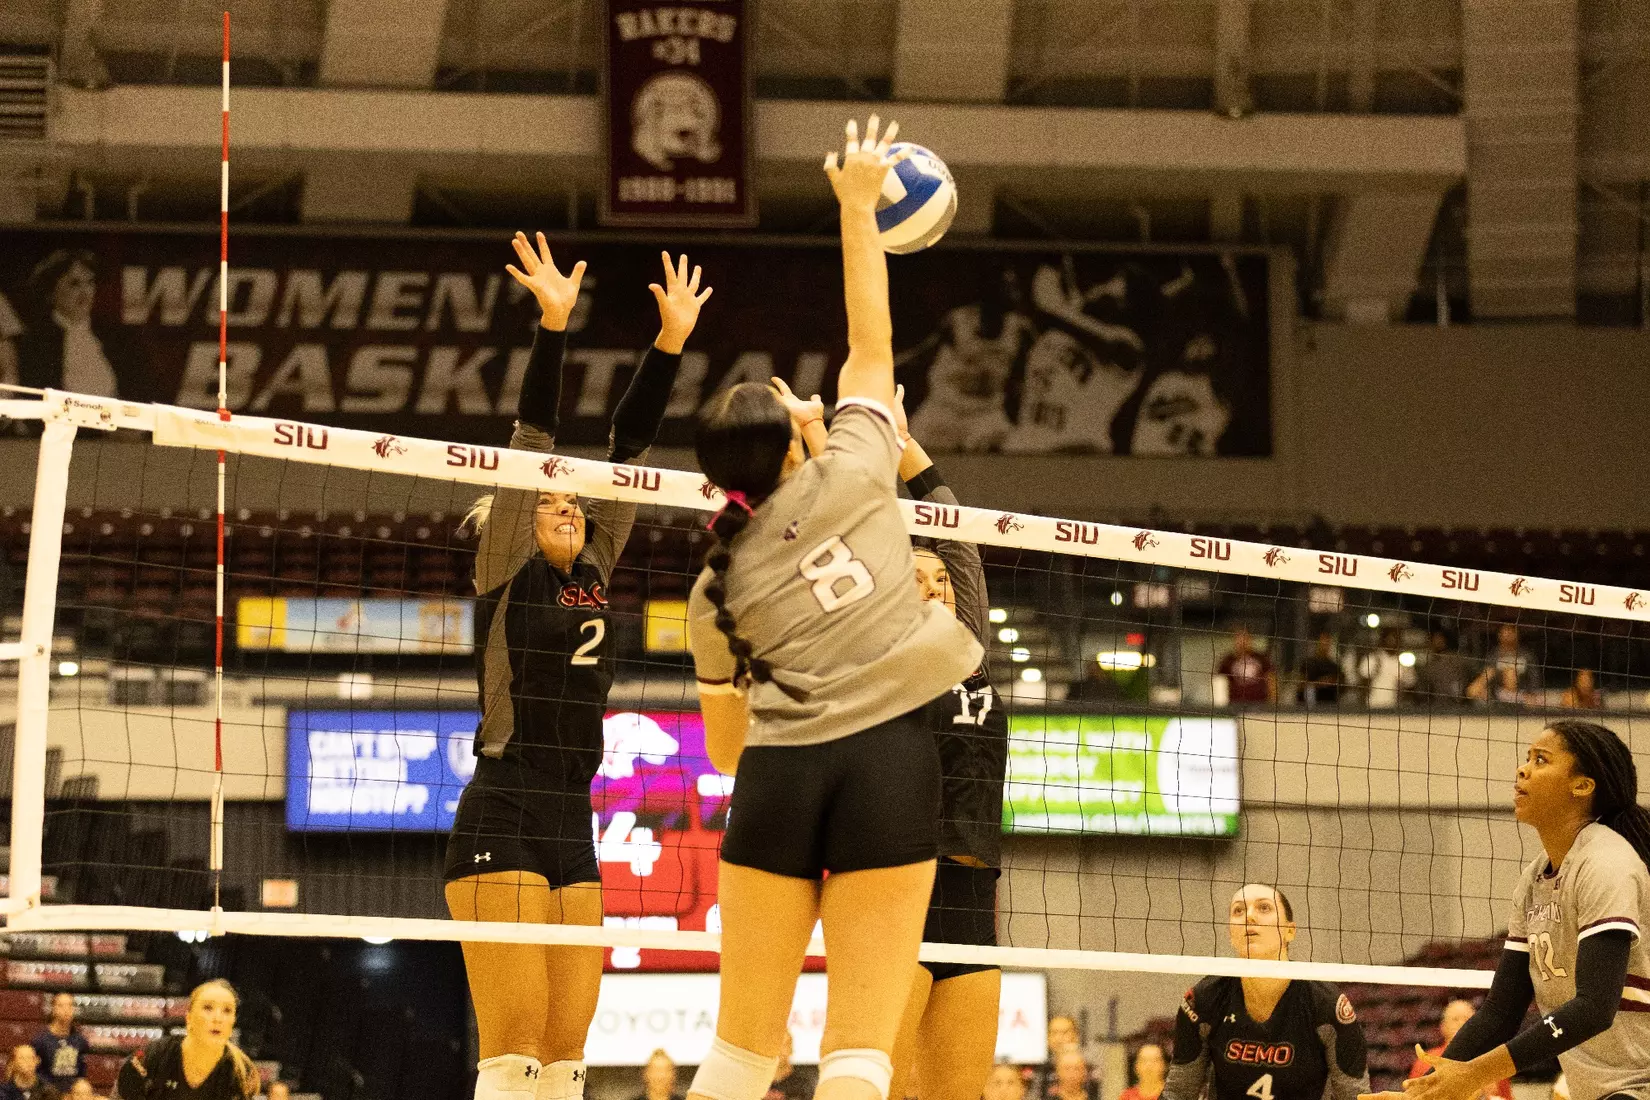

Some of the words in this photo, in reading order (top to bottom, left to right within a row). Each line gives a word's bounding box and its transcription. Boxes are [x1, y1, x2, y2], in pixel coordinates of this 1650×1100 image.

[175, 341, 830, 416] BASKTBA
[273, 420, 328, 450] SIU
[446, 440, 499, 471] SIU
[611, 465, 661, 492] SIU
[914, 504, 960, 529] SIU
[1054, 521, 1099, 545] SIU
[1189, 538, 1231, 561] SIU
[1318, 554, 1358, 577] SIU
[1441, 569, 1480, 592] SIU
[1558, 584, 1595, 606] SIU
[798, 534, 876, 613] 8
[570, 617, 606, 666] 2
[951, 682, 993, 726] 17
[597, 1009, 714, 1033] OYOTA
[1226, 1040, 1293, 1067] SEMO
[1246, 1073, 1275, 1100] 4
